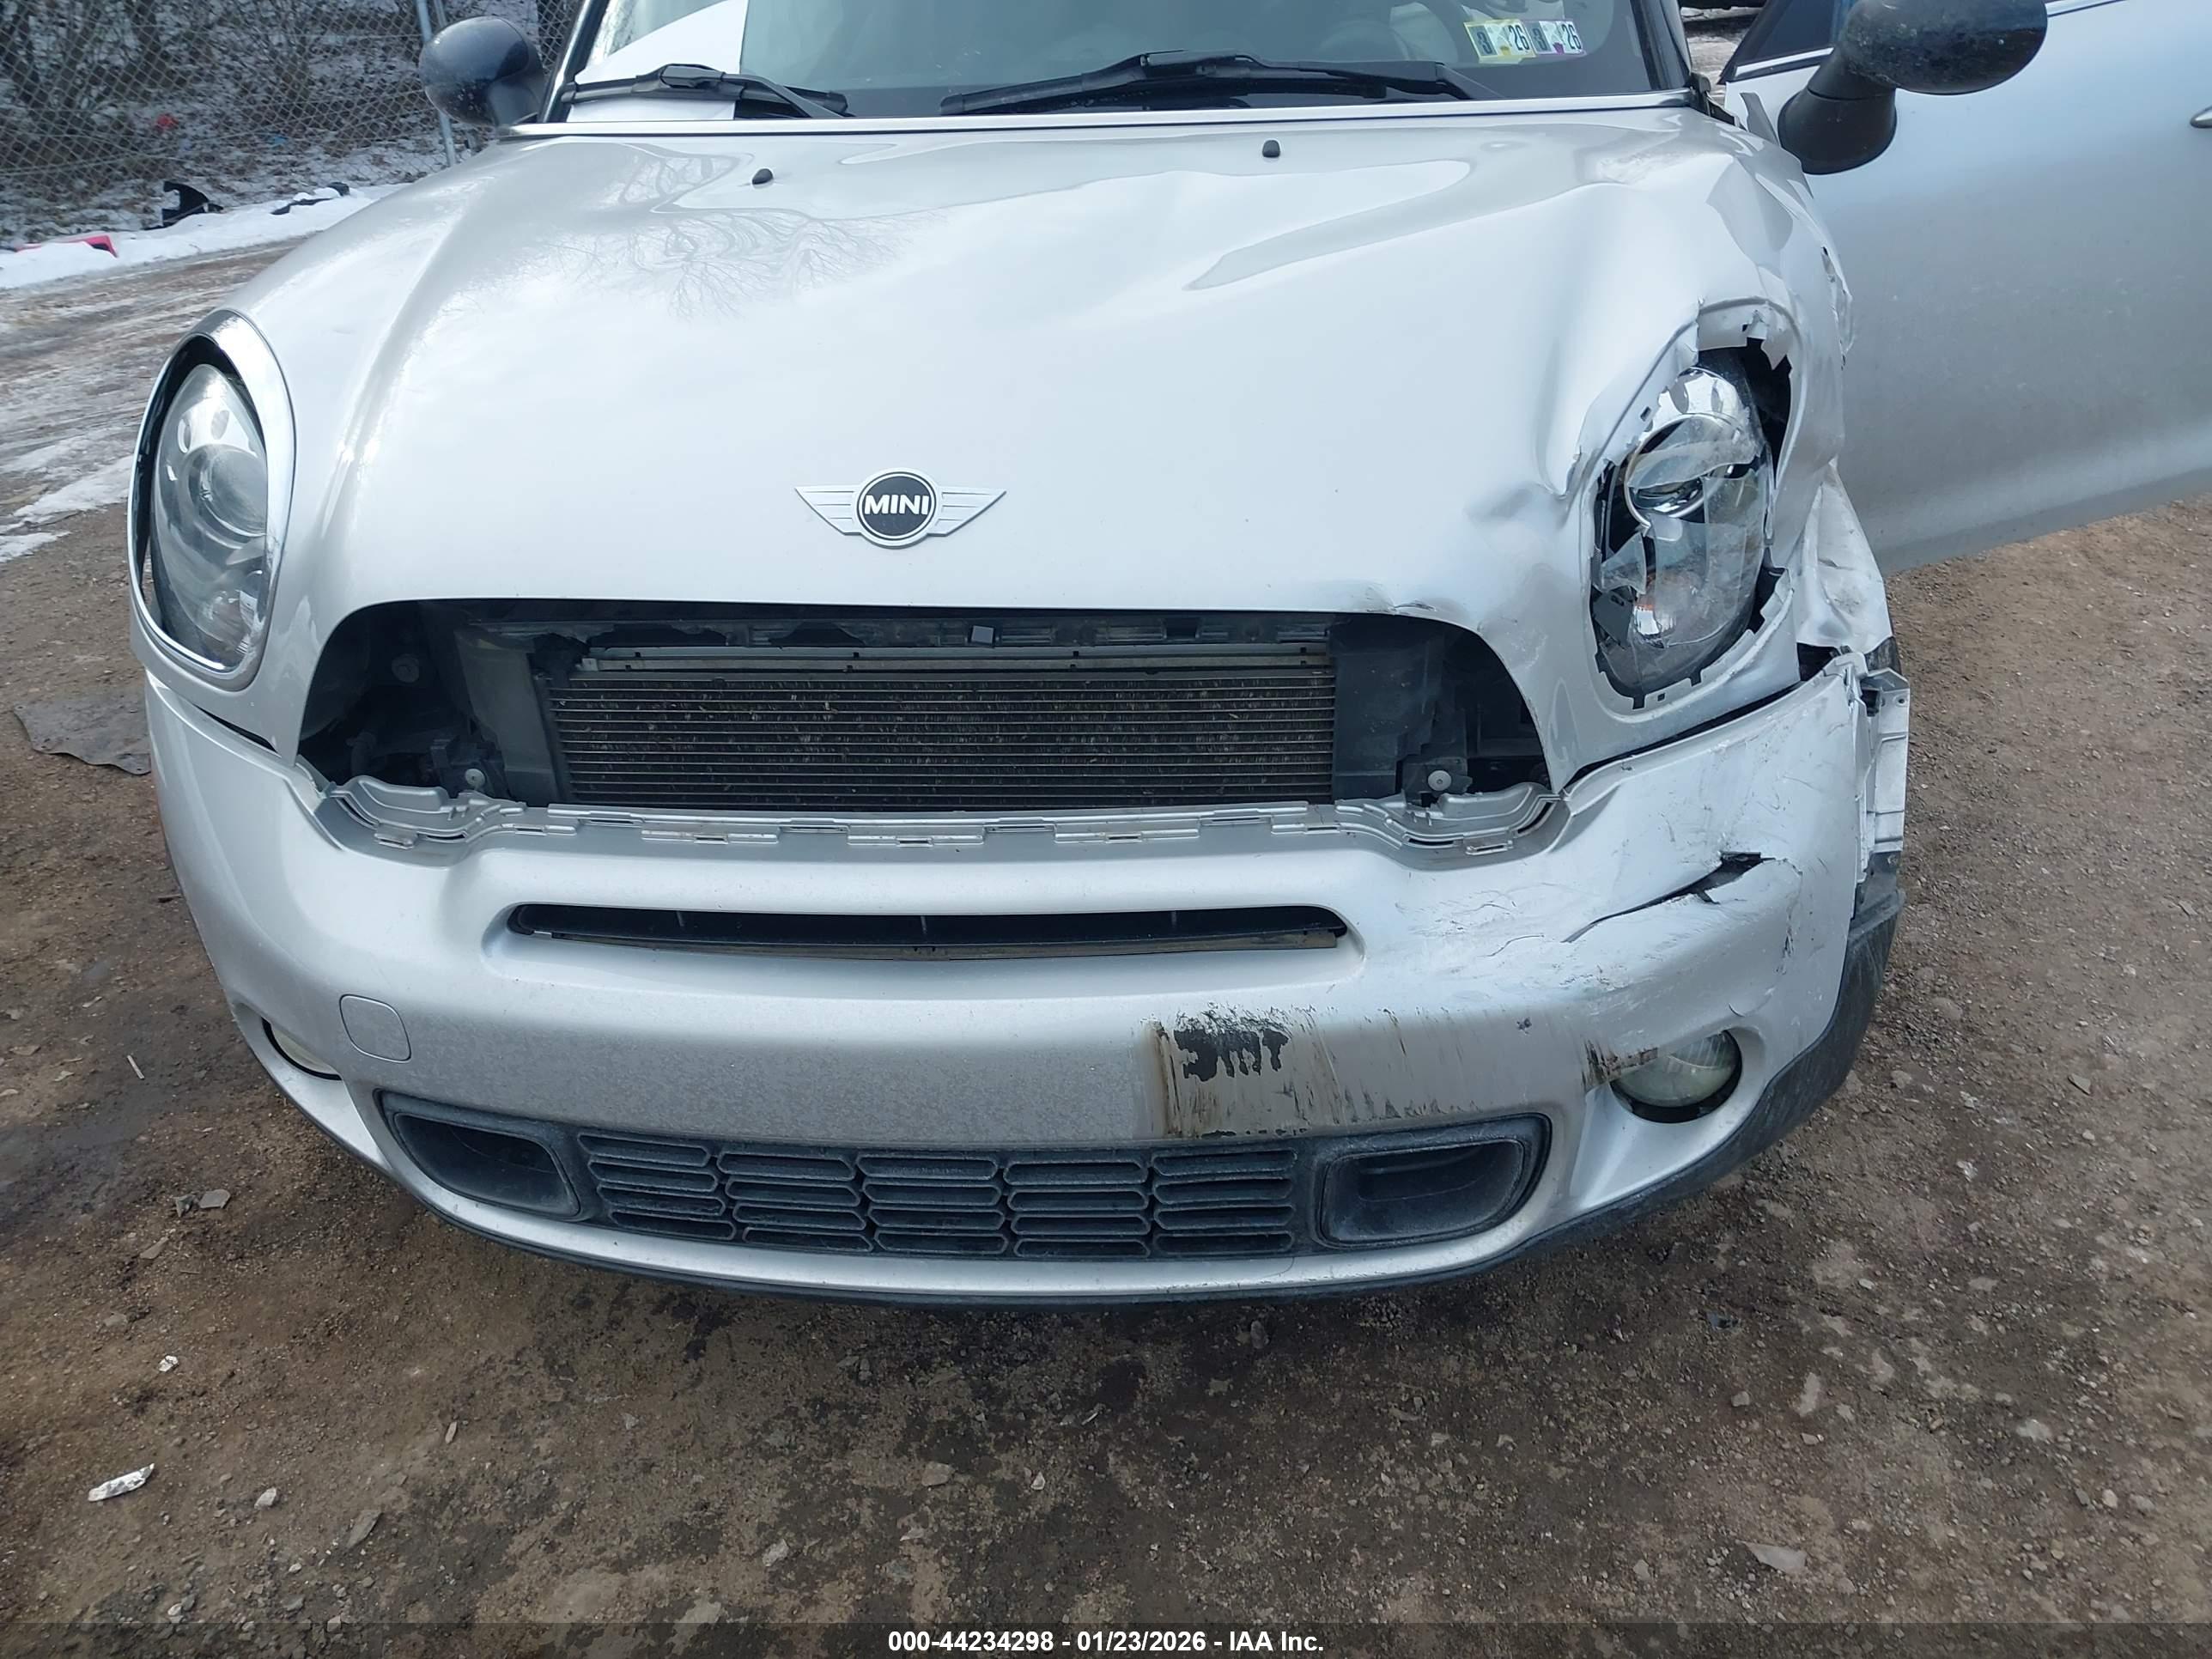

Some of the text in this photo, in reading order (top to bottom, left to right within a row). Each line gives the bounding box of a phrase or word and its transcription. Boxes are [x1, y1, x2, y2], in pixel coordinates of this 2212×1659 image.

[1476, 31, 1493, 55] 3
[1508, 24, 1530, 52] 26
[1531, 27, 1547, 51] 3
[1561, 23, 1582, 50] 26
[864, 494, 930, 515] MINI
